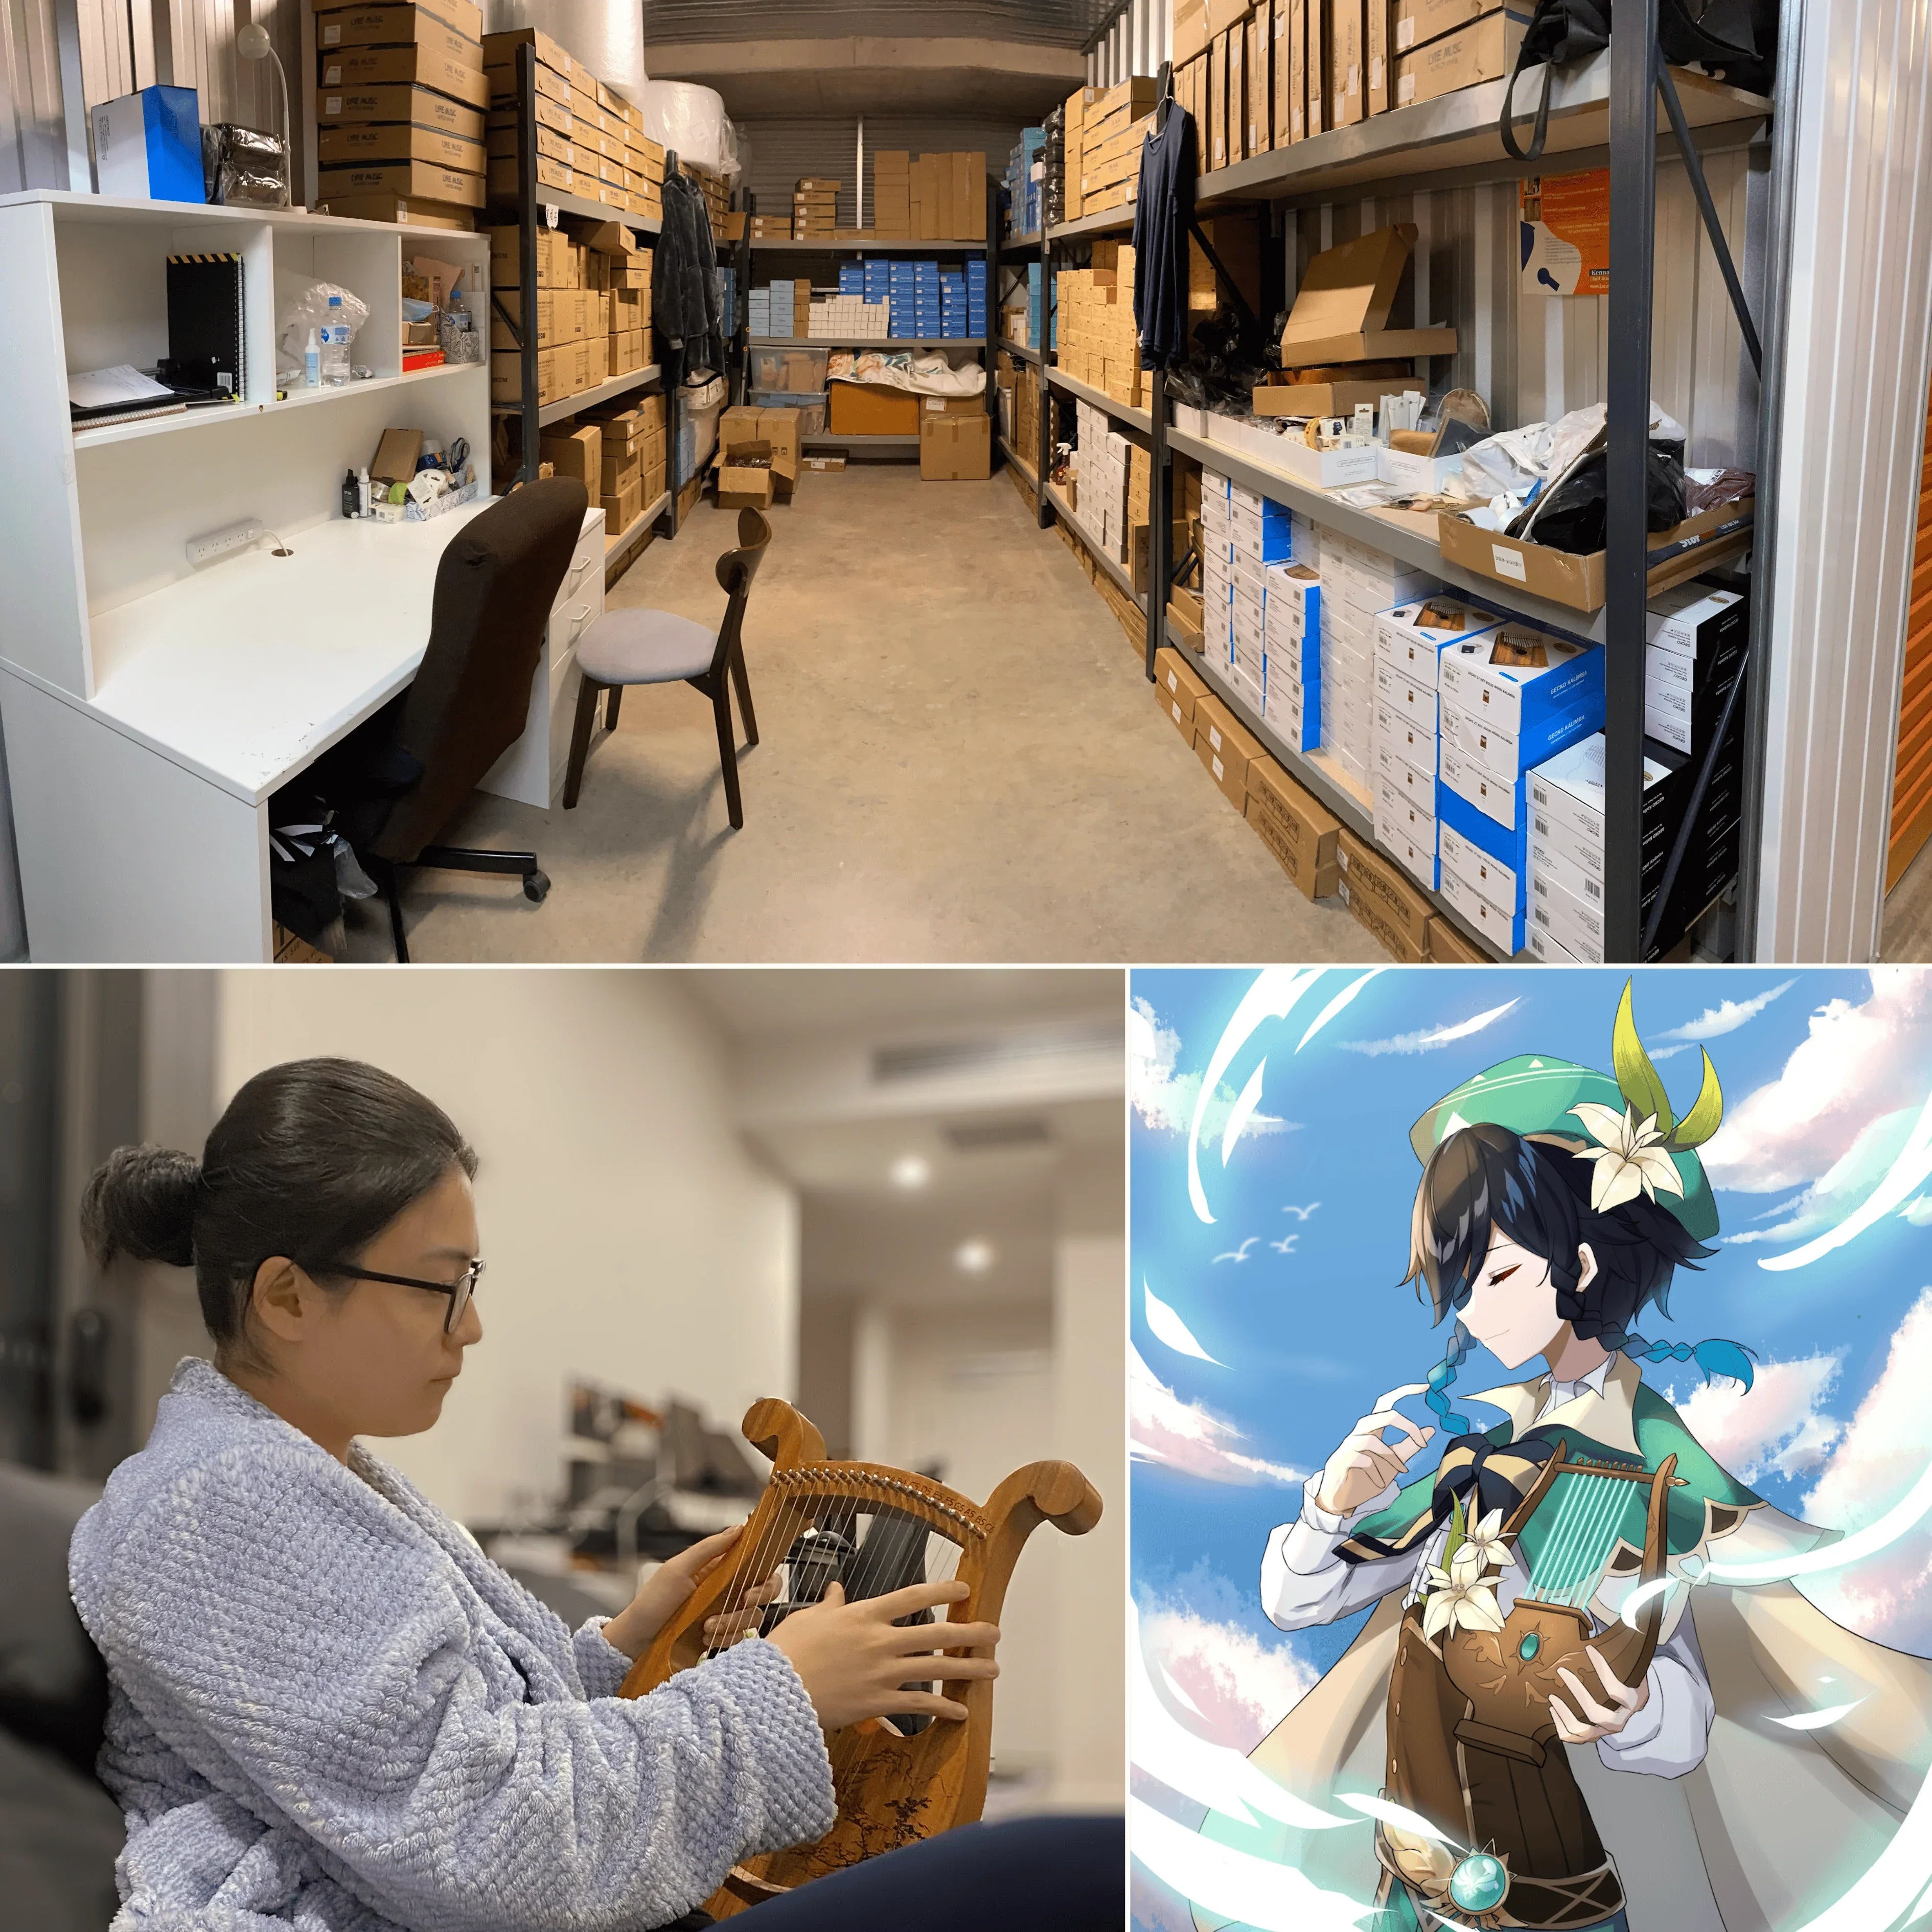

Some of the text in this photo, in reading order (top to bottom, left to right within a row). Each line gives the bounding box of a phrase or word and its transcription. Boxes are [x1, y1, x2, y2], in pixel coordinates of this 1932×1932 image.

[444, 62, 465, 79] LYRE MUSIC
[347, 97, 359, 105] LYRE
[434, 104, 456, 117] LYRE MUSIC
[441, 140, 463, 152] LYRE MUSIC
[351, 172, 382, 181] LYRE MUSIC
[442, 174, 463, 186] LYRE MUSIC
[1679, 535, 1700, 548] Stor
[1550, 671, 1588, 695] GECKO KALIMBA
[1502, 689, 1515, 699] KALIMBA
[1548, 715, 1585, 741] GECKO KALIMBA
[1491, 730, 1500, 739] WOOD
[1500, 735, 1513, 745] KALIMBA
[1672, 735, 1685, 743] GECKO
[1498, 784, 1510, 794] KALIMBA
[1652, 796, 1665, 808] GECKO
[1587, 827, 1600, 838] GECKO
[1653, 826, 1665, 839] GECKO
[1533, 845, 1545, 855] GECKO
[1650, 852, 1663, 864] Kalimba
[1588, 861, 1601, 871] GECKO
[1498, 868, 1510, 880] KALIMBA
[1587, 925, 1600, 936] GECKO
[922, 1485, 933, 1494] D5
[933, 1491, 944, 1500] E5
[946, 1496, 955, 1506] F5
[954, 1502, 966, 1512] G5
[964, 1508, 976, 1518] A5
[975, 1515, 986, 1526] B5
